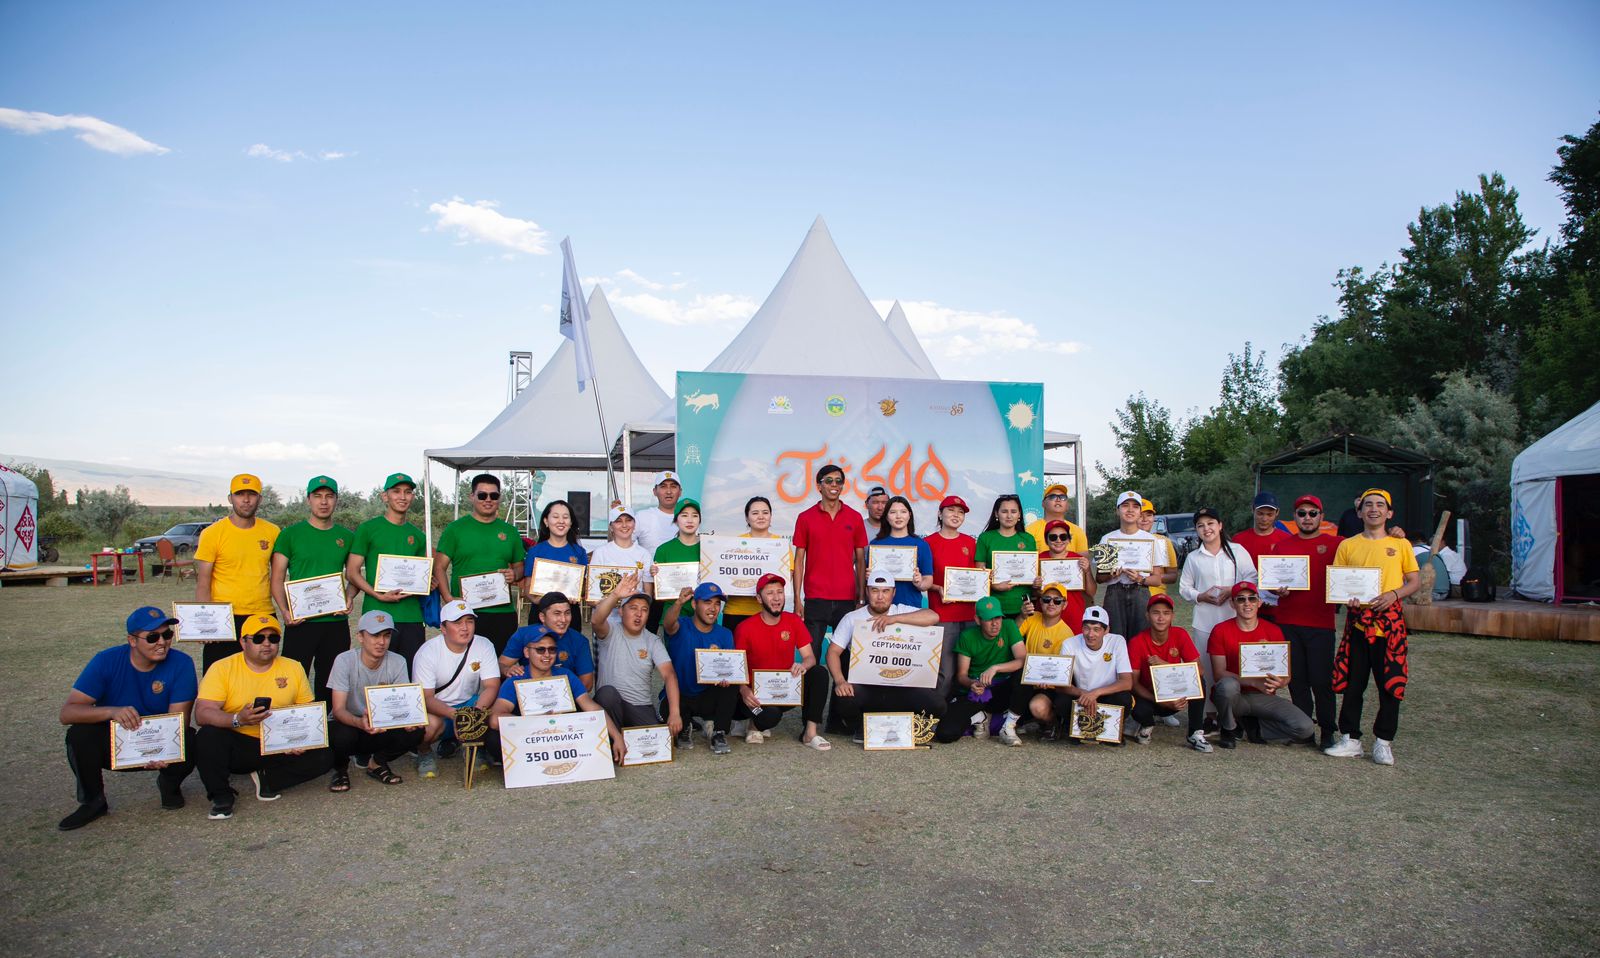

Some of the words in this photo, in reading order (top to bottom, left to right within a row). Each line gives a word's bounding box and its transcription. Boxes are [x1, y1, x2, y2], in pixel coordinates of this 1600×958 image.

[720, 553, 770, 561] СЕРТИФИКАТ
[719, 566, 739, 576] 500
[742, 567, 762, 576] 000
[871, 640, 922, 651] СЕРТИФИКАТ
[868, 654, 888, 665] 700
[891, 656, 912, 667] 000
[525, 732, 585, 744] СЕРТИФИКАТ
[525, 751, 550, 763] 350
[554, 748, 578, 760] 000
